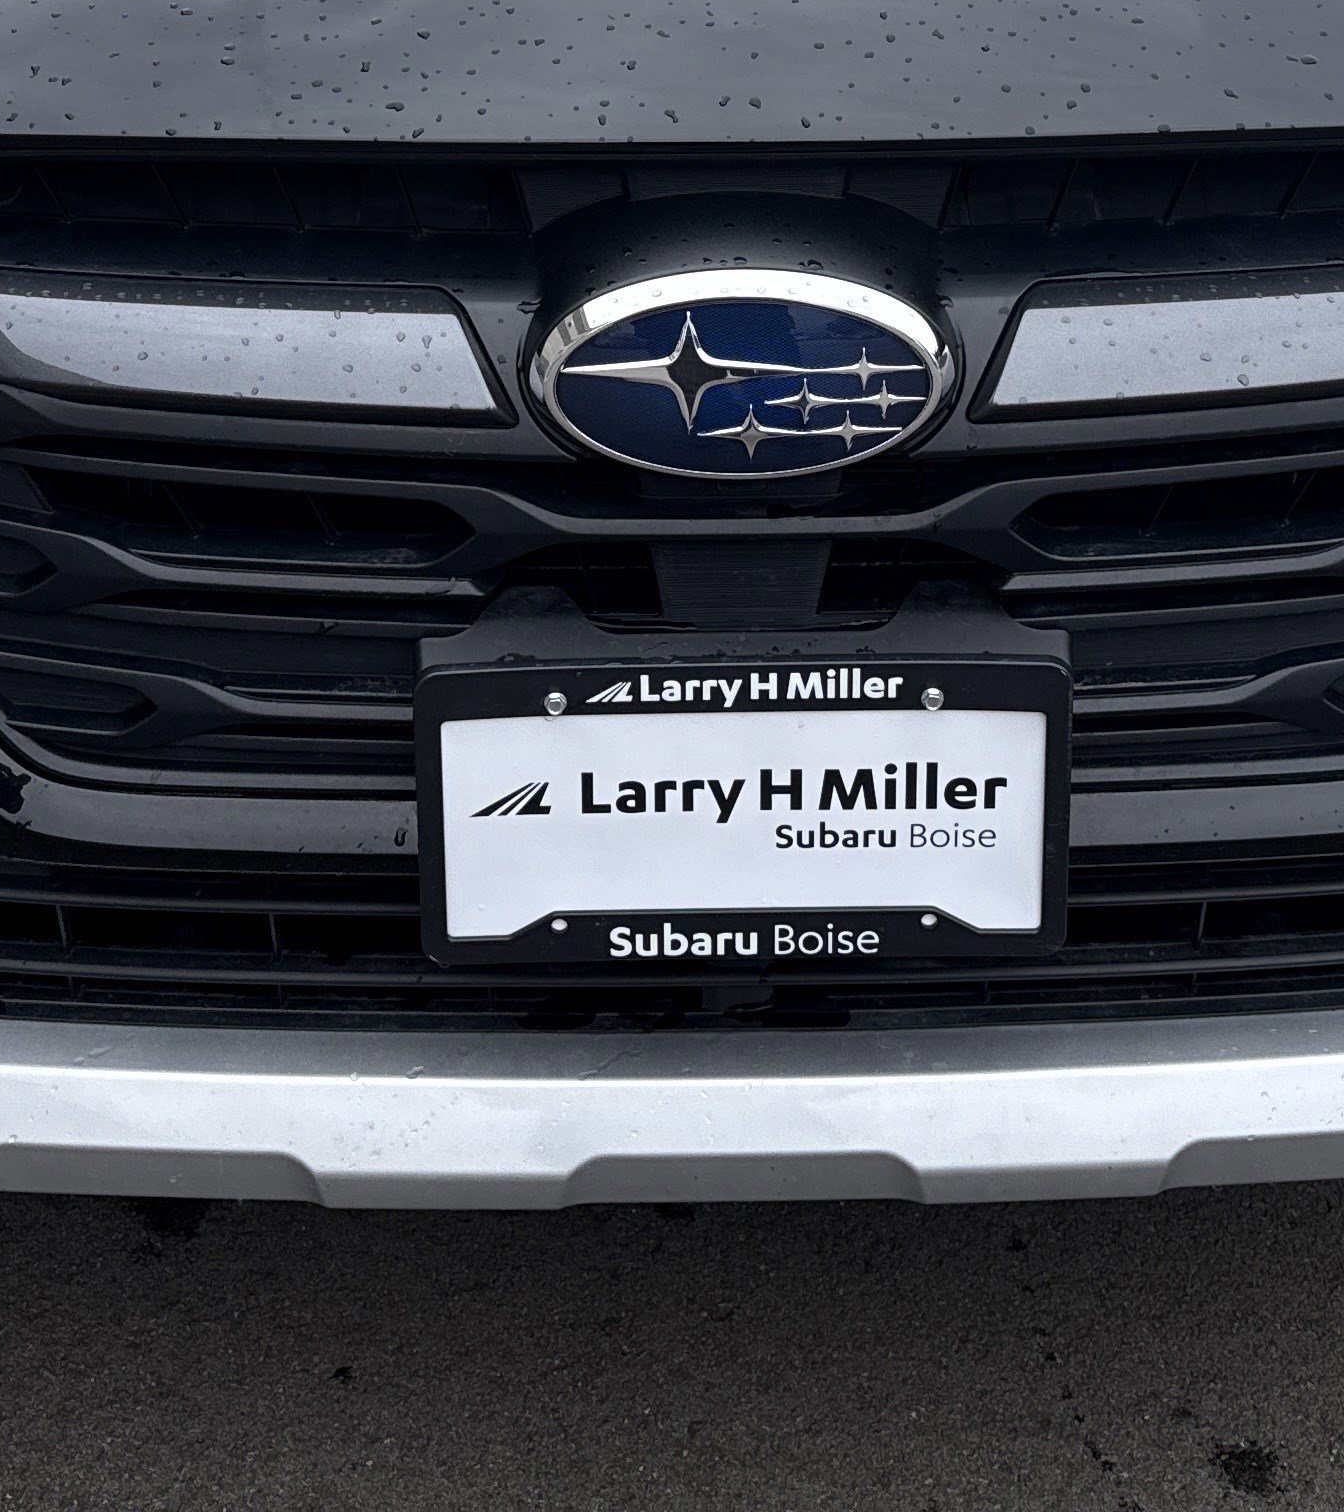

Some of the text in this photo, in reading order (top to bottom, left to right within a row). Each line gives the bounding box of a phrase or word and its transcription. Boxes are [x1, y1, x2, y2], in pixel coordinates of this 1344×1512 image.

[639, 667, 904, 708] Larry H Miller
[580, 761, 1008, 824] Larry H Miller
[775, 821, 997, 849] Subaru Boise
[609, 922, 880, 957] Subaru Boise
